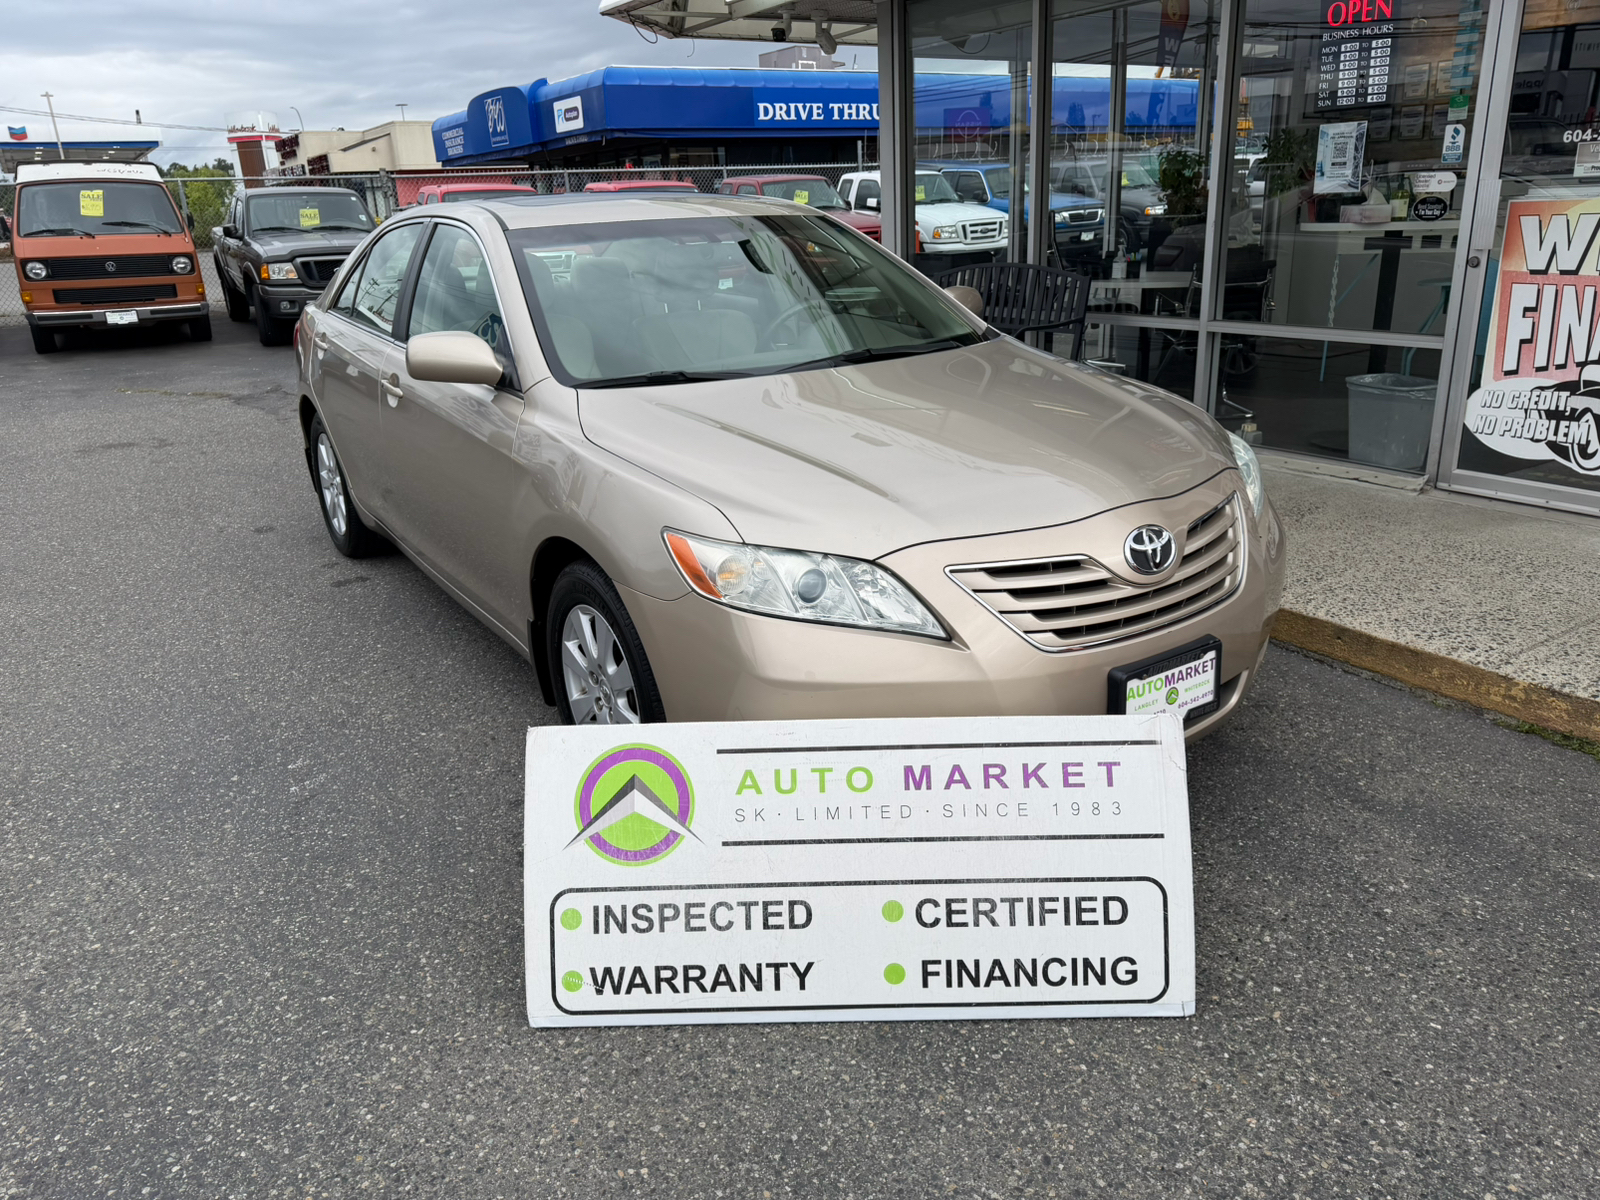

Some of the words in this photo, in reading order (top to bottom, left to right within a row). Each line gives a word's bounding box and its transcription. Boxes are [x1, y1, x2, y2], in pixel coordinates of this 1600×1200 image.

[1327, 0, 1393, 26] OPEN
[1322, 29, 1359, 41] BUSINESS
[1362, 24, 1394, 36] HOURS
[1322, 46, 1338, 54] MON
[1320, 73, 1334, 81] THU
[1321, 64, 1336, 72] WED
[1319, 82, 1329, 90] FRI
[757, 102, 824, 121] DRIVE
[1519, 213, 1600, 275] W
[1481, 390, 1505, 409] NO
[1506, 390, 1571, 416] CREDIT,
[1473, 414, 1498, 436] NO
[1499, 415, 1590, 445] PROBLEM
[1134, 699, 1159, 711] LANGLEY
[737, 767, 874, 796] AUTO
[903, 761, 1121, 791] MARKET
[796, 804, 913, 821] LIMITED
[942, 802, 1029, 818] SINCE
[1053, 801, 1123, 816] 1983
[592, 899, 813, 935] INSPECTED
[916, 895, 1129, 929] CERTIFIED
[590, 961, 815, 996] WARRANTY
[922, 955, 1139, 989] FINANCING
